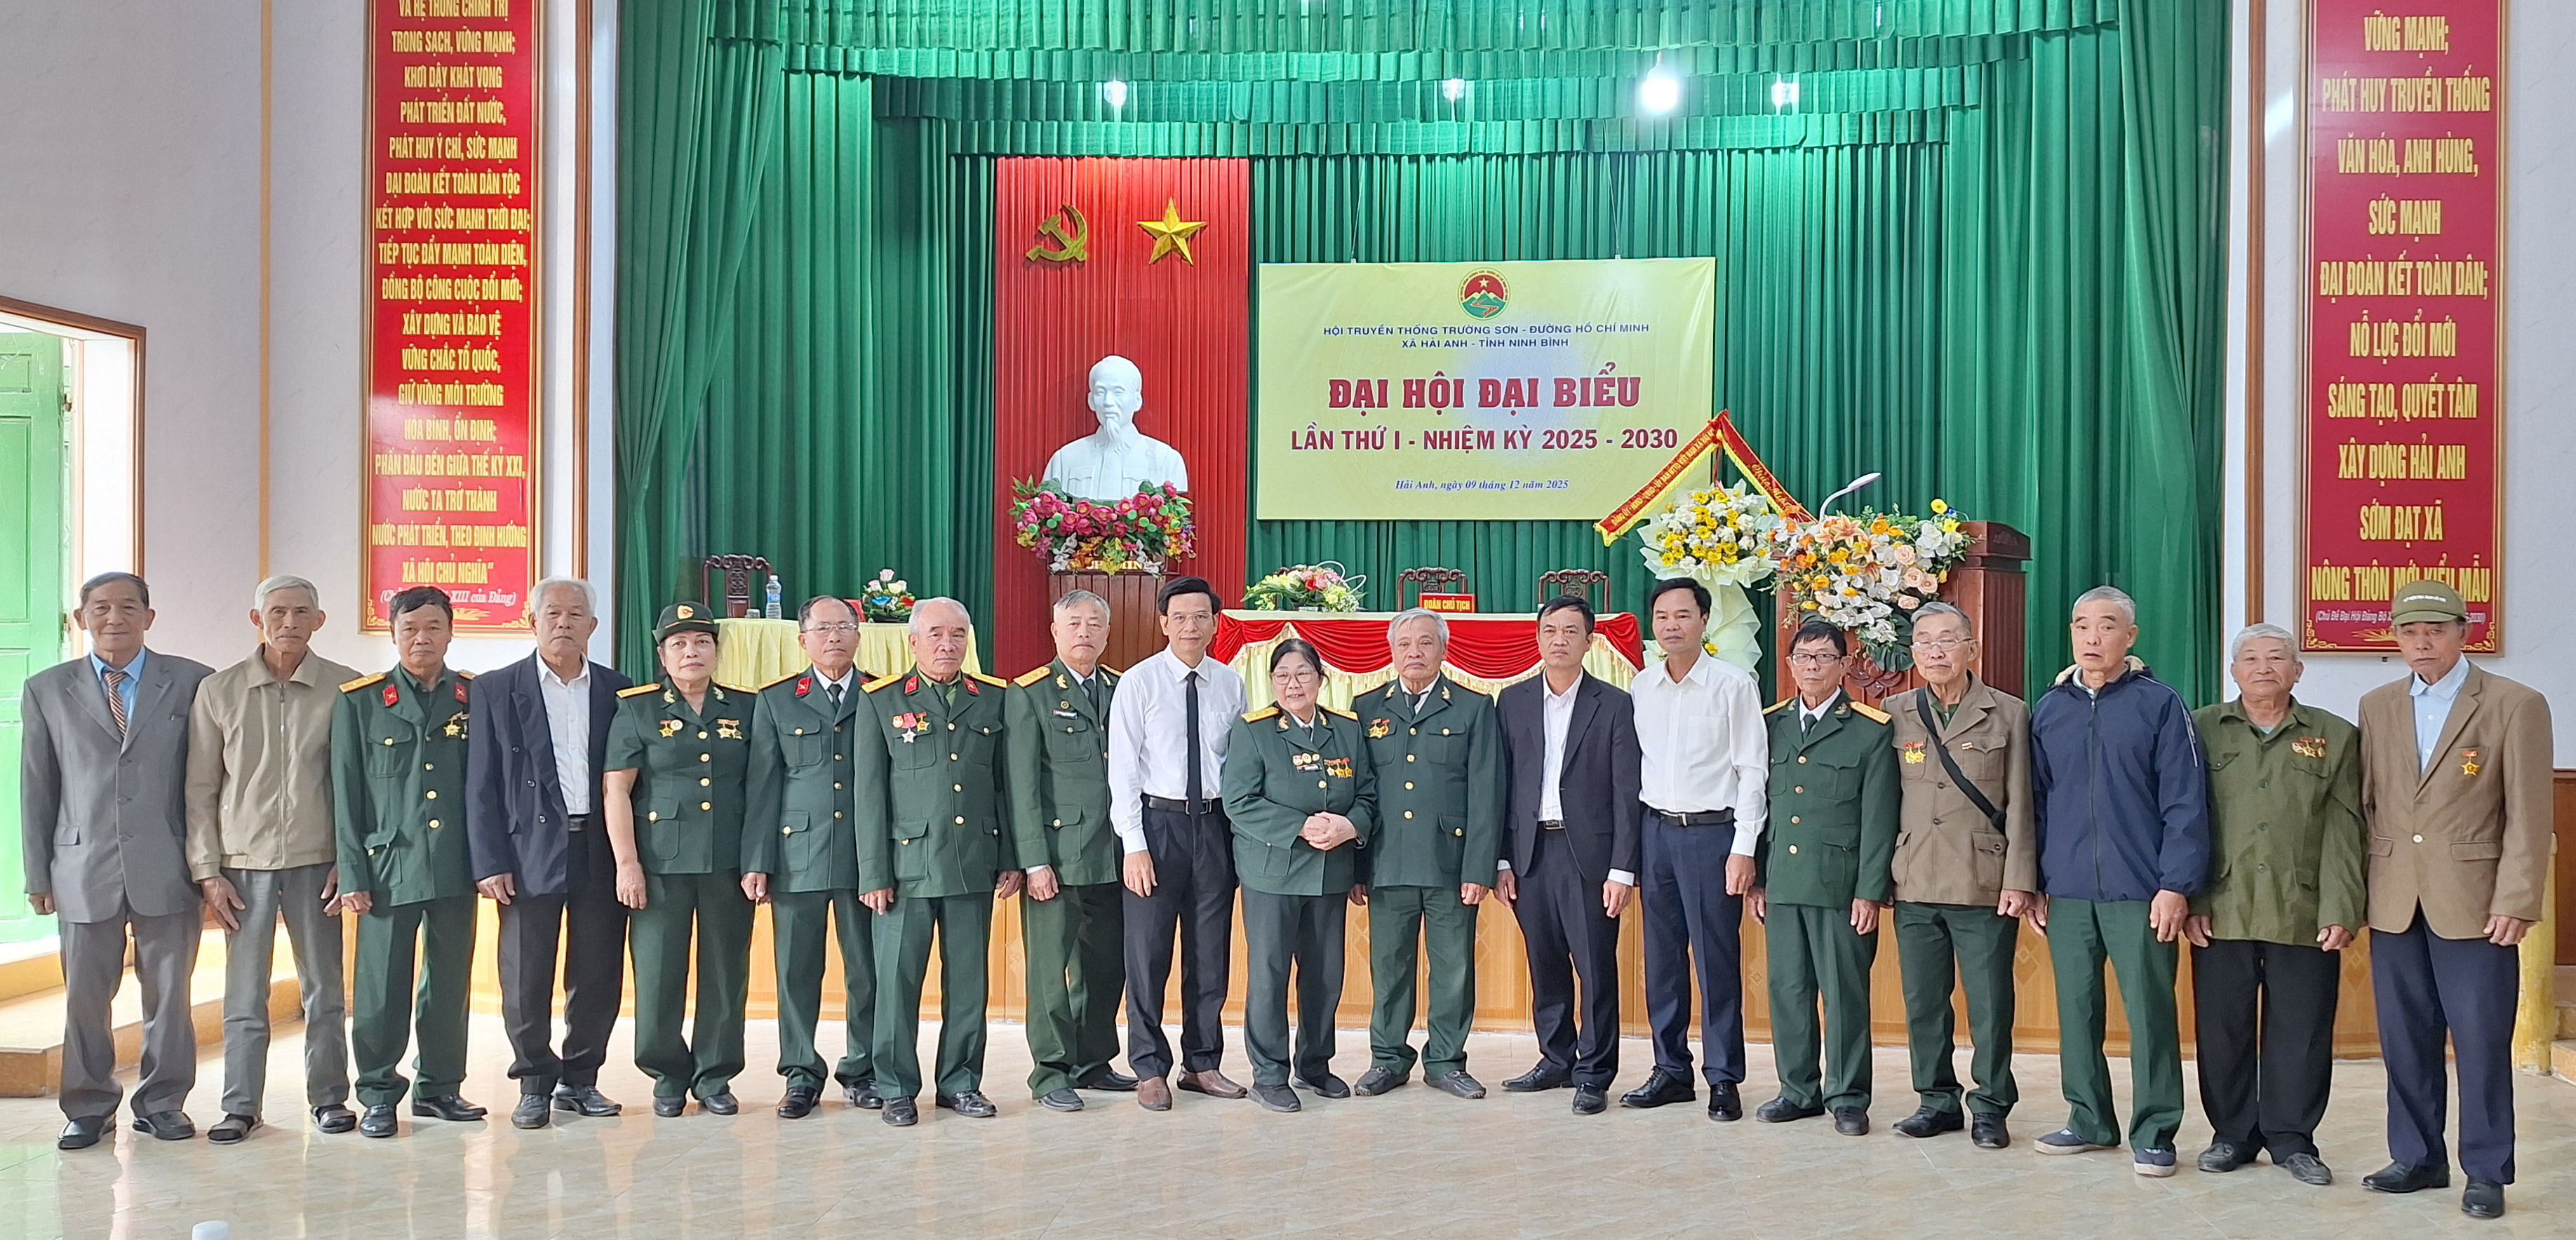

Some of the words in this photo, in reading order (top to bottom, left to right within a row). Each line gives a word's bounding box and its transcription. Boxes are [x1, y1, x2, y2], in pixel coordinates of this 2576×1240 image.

[391, 31, 423, 52] TRONG
[425, 32, 453, 56] SẠCH,
[455, 26, 481, 52] VỮNG
[483, 32, 516, 57] MẠNH;
[2363, 11, 2401, 50] VỮNG
[2404, 16, 2449, 58] MẠNH;
[2321, 71, 2357, 112] PHÁT
[2360, 79, 2387, 112] HUY
[2390, 67, 2442, 112] TRUYỀN
[2445, 65, 2490, 112] THỐNG
[389, 133, 415, 158] PHÁT
[415, 137, 435, 159] HUY
[436, 133, 443, 158] Ý
[445, 133, 464, 161] CHÍ,
[466, 131, 486, 159] SỨC
[488, 137, 518, 163] MẠNH
[2337, 133, 2366, 173] VĂN
[2368, 132, 2400, 177] HÓA,
[2403, 140, 2432, 173] ANH
[2436, 132, 2478, 176] HÙNG,
[385, 173, 402, 197] ĐẠI
[403, 168, 431, 194] ĐOÀN
[432, 166, 450, 194] KẾT
[452, 169, 478, 194] TOÀN
[479, 169, 500, 194] DÂN
[502, 168, 521, 198] TỘC
[375, 201, 394, 229] KẾT
[395, 207, 415, 233] HỢP
[416, 203, 433, 229] VỚI
[434, 202, 455, 229] SỨC
[456, 208, 485, 234] MẠNH
[487, 203, 509, 229] THỜI
[510, 208, 532, 234] ĐẠI;
[2368, 193, 2396, 234] SỨC
[2400, 201, 2441, 242] MẠNH
[378, 236, 399, 264] TIẾP
[401, 243, 420, 269] TỤC
[421, 235, 441, 264] ĐẨY
[442, 243, 471, 269] MẠNH
[473, 240, 499, 264] TOÀN
[382, 271, 408, 299] ĐỒNG
[410, 274, 424, 304] BỘ
[425, 274, 452, 299] CÔNG
[454, 275, 480, 304] CUỘC
[482, 271, 499, 300] ĐỔI
[2319, 262, 2344, 303] ĐẠI
[2346, 254, 2384, 295] ĐOÀN
[2387, 250, 2413, 295] KẾT
[2415, 254, 2452, 295] TOÀN
[2455, 254, 2488, 299] DÂN;
[403, 309, 422, 335] XÂY
[423, 312, 450, 339] DỰNG
[452, 310, 465, 335] VÀ
[467, 305, 487, 335] BẢO
[488, 310, 502, 340] VỆ
[1324, 325, 1343, 337] HỘI
[1346, 324, 1393, 335] TRUYỀN
[1397, 324, 1438, 335] THỐNG
[1442, 325, 1491, 335] TRƯỜNG
[1494, 325, 1518, 335] SƠN
[1529, 323, 1571, 334] ĐƯỜNG
[1576, 322, 1592, 333] HỒ
[1596, 323, 1616, 332] CHÍ
[1619, 324, 1649, 332] MINH
[2350, 310, 2370, 356] NỖ
[2373, 319, 2399, 364] LỰC
[2402, 309, 2426, 356] ĐỔI
[2429, 316, 2456, 356] MỚI
[401, 344, 428, 370] VỮNG
[429, 343, 456, 370] CHẮC
[457, 341, 470, 370] TỔ
[471, 342, 501, 373] QUỐC,
[1402, 337, 1417, 348] XÃ
[1421, 337, 1440, 348] HẢI
[1443, 339, 1468, 348] ANH
[1478, 337, 1505, 348] TỈNH
[1509, 339, 1537, 347] NINH
[1541, 337, 1569, 347] BÌNH
[398, 379, 415, 405] GIỮ
[416, 379, 443, 407] VỮNG
[444, 380, 464, 405] MÔI
[465, 379, 504, 405] TRƯỜNG
[1329, 379, 1388, 417] ĐẠI
[1402, 370, 1465, 416] HỘI
[1478, 377, 1539, 417] ĐẠI
[1553, 361, 1642, 407] BIỂU
[2328, 376, 2366, 417] SÁNG
[2368, 384, 2399, 425] TẠO,
[2402, 372, 2445, 421] QUYẾT
[2447, 377, 2477, 417] TÂM
[1292, 422, 1334, 450] LẦN
[1341, 424, 1387, 450] THỨ
[1394, 430, 1400, 450] I
[1423, 424, 1495, 454] NHIỆM
[1503, 424, 1533, 450] KỲ
[1541, 429, 1597, 450] 2025
[1621, 429, 1678, 449] 2030
[2338, 438, 2366, 478] XÂY
[2368, 441, 2407, 486] DỰNG
[2410, 433, 2433, 478] HẢI
[2436, 445, 2466, 479] ANH
[402, 483, 429, 511] NƯỚC
[431, 490, 443, 511] TA
[445, 481, 464, 511] TRỞ
[465, 486, 497, 511] THÀNH
[1395, 480, 1413, 490] Hải
[1416, 480, 1437, 490] Anh,
[1440, 480, 1463, 491] ngày
[1465, 480, 1476, 489] 09
[1479, 480, 1505, 491] tháng
[1510, 480, 1520, 489] 12
[1522, 480, 1543, 489] năm
[1545, 480, 1569, 489] 2025
[372, 518, 396, 546] NƯỚC
[396, 520, 420, 546] PHÁT
[450, 525, 473, 546] THEO
[473, 525, 496, 551] ĐỊNH
[496, 520, 528, 547] HƯỚNG
[2359, 499, 2391, 539] SỚM
[2394, 506, 2421, 547] ĐẠT
[2424, 500, 2443, 539] XÃ
[402, 558, 415, 583] XÃ
[436, 553, 455, 583] CHỦ
[2312, 559, 2350, 601] NÔNG
[2354, 559, 2389, 601] THÔN
[2459, 554, 2490, 603] MẪU
[450, 590, 470, 602] XIII
[471, 588, 486, 602] của
[488, 588, 516, 607] Đảng)
[1424, 598, 1441, 609] ĐOÀN
[1442, 598, 1455, 610] CHỦ
[1456, 600, 1470, 612] TỊCH
